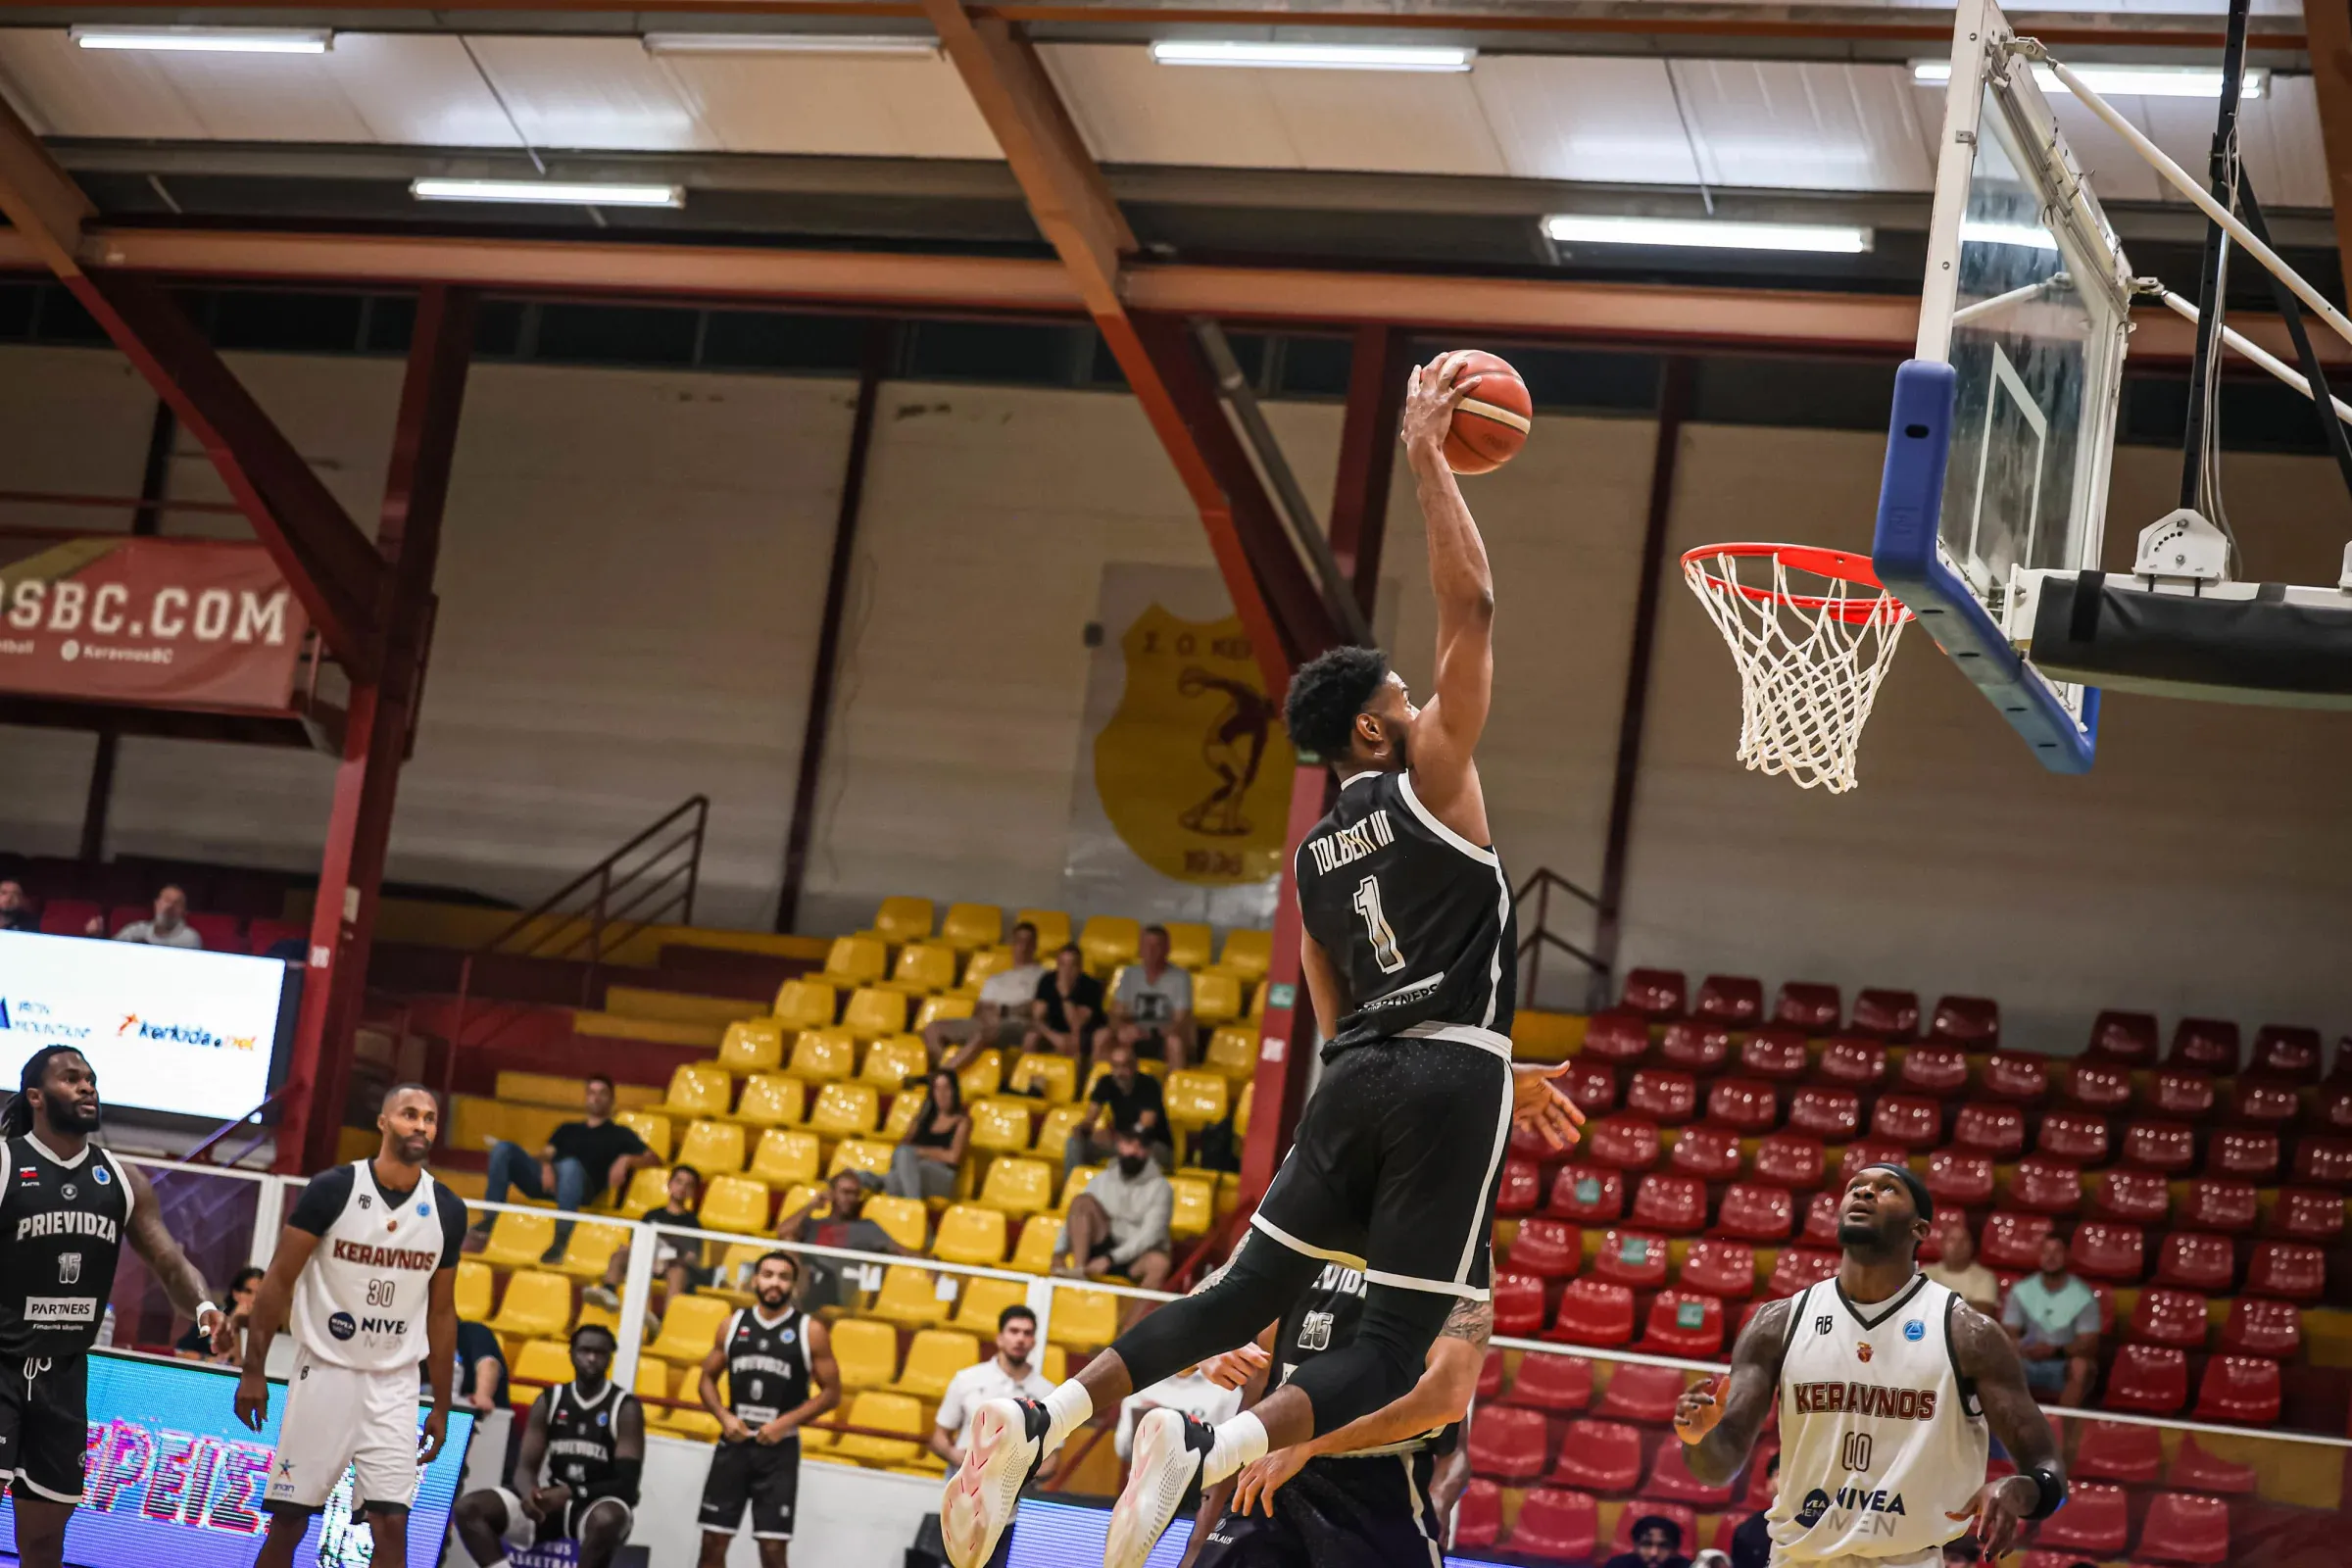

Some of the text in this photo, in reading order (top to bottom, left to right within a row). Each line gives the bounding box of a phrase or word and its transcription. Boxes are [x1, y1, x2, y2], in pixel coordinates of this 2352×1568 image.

[0, 576, 291, 647] SBC.COM
[0, 639, 34, 655] tball
[1308, 809, 1396, 876] TOLBERT III
[1352, 874, 1406, 975] 1
[16, 1211, 117, 1244] PRIEVIDZA
[58, 1252, 82, 1284] 15
[333, 1238, 437, 1272] KERAVNOS
[367, 1278, 395, 1308] 30
[1310, 1263, 1368, 1299] VID
[31, 1303, 90, 1315] PARTNERS
[1297, 1309, 1335, 1351] 25
[1792, 1381, 1936, 1421] KERAVNOS
[1806, 1499, 1826, 1508] VEA
[1829, 1510, 1896, 1537] MEN
